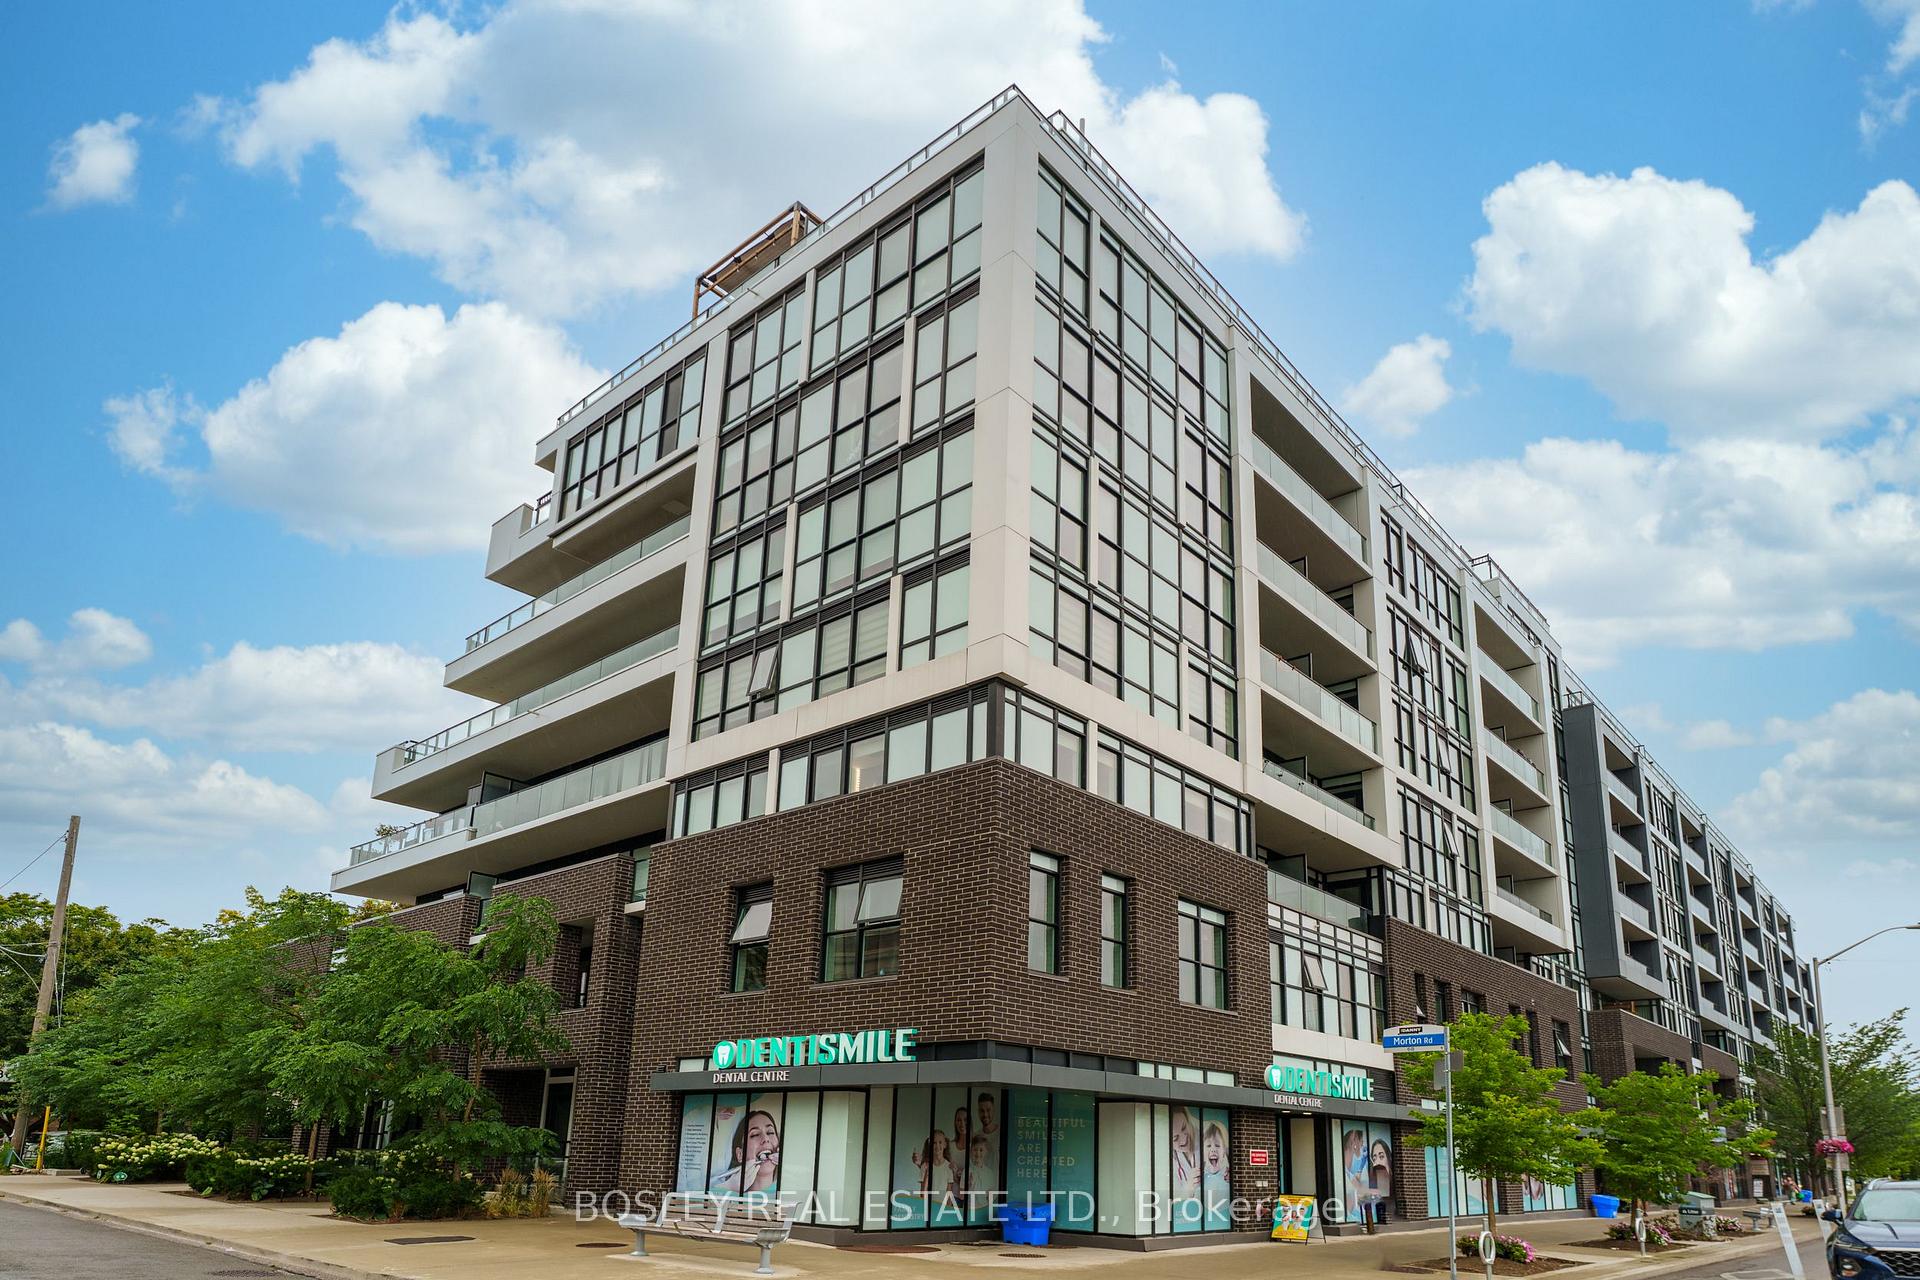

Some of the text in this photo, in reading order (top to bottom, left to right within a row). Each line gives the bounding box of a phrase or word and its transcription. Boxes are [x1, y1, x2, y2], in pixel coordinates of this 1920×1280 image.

[1393, 1037, 1422, 1046] Morton
[736, 1028, 917, 1068] DENTISMILE
[713, 1070, 790, 1084] DENTAL CENTRE
[1284, 1065, 1375, 1101] DENTISMILE
[1274, 1094, 1323, 1108] DENTAL CENTRE
[1017, 1130, 1065, 1140] SMILES
[1017, 1143, 1041, 1153] ARE
[1017, 1168, 1047, 1178] HERE
